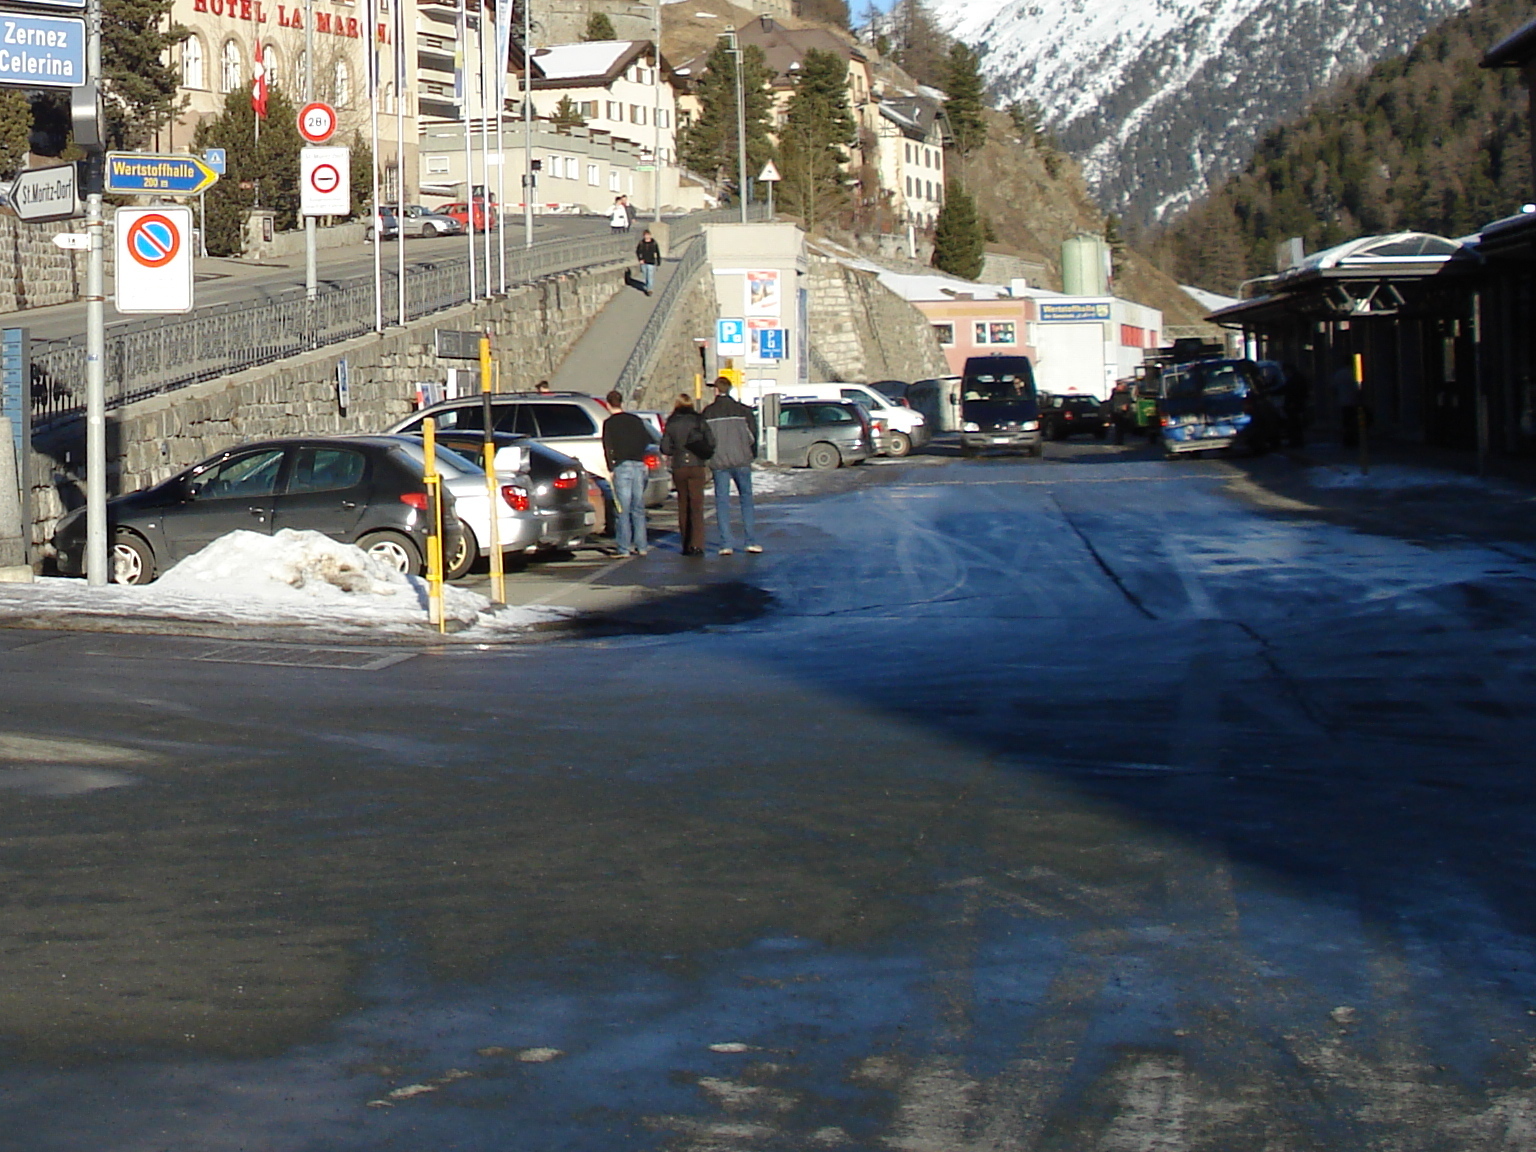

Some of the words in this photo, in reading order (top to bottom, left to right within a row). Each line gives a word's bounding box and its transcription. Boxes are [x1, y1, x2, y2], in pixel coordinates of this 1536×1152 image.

[278, 5, 304, 29] LA
[4, 21, 67, 48] Zernez
[722, 322, 737, 342] P
